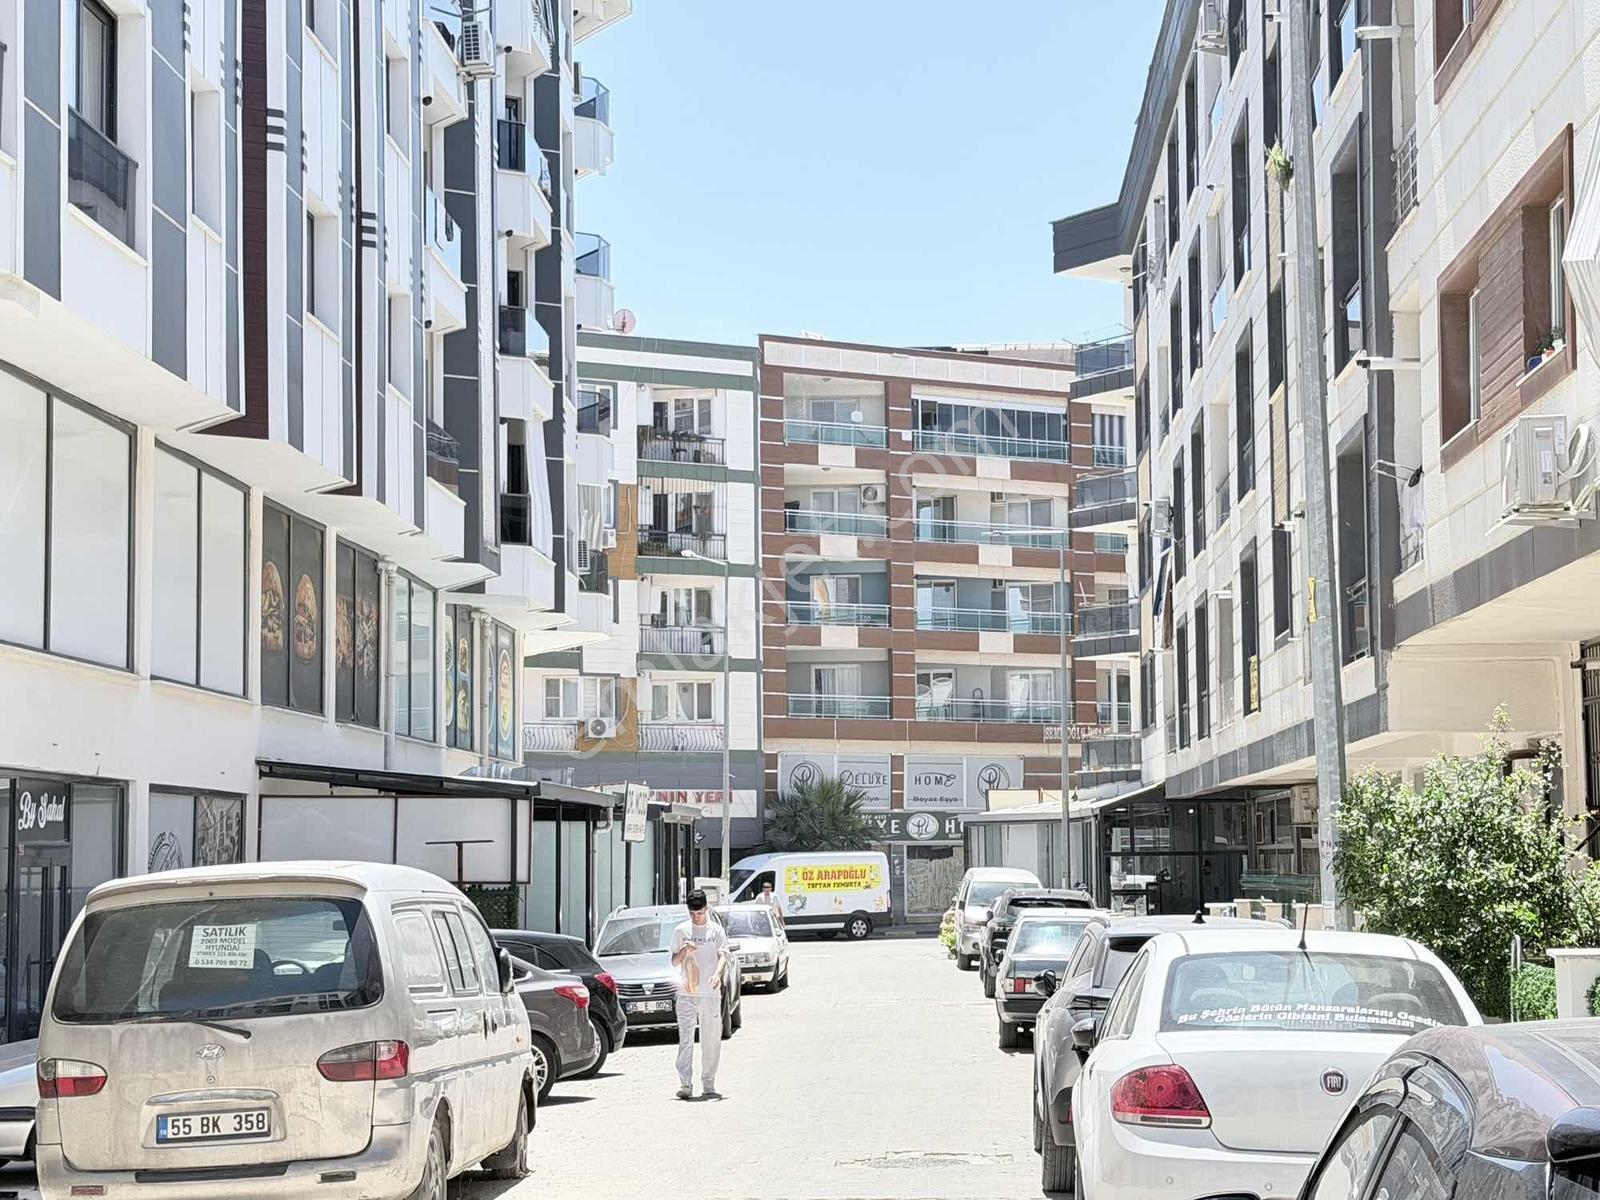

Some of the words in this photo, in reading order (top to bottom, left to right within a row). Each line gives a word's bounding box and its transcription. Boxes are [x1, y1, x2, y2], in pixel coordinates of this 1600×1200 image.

[914, 773, 957, 787] HOME
[18, 791, 37, 830] By
[802, 868, 815, 881] ÖZ
[817, 867, 867, 881] ARAPOĞLU
[202, 927, 247, 937] SATILIK
[220, 937, 246, 945] MODEL
[1178, 1013, 1198, 1024] Bu
[1250, 1004, 1293, 1013] Bütün
[1326, 1076, 1343, 1089] FIAT
[171, 1118, 192, 1136] 55
[200, 1116, 221, 1134] BK
[233, 1113, 265, 1131] 358
